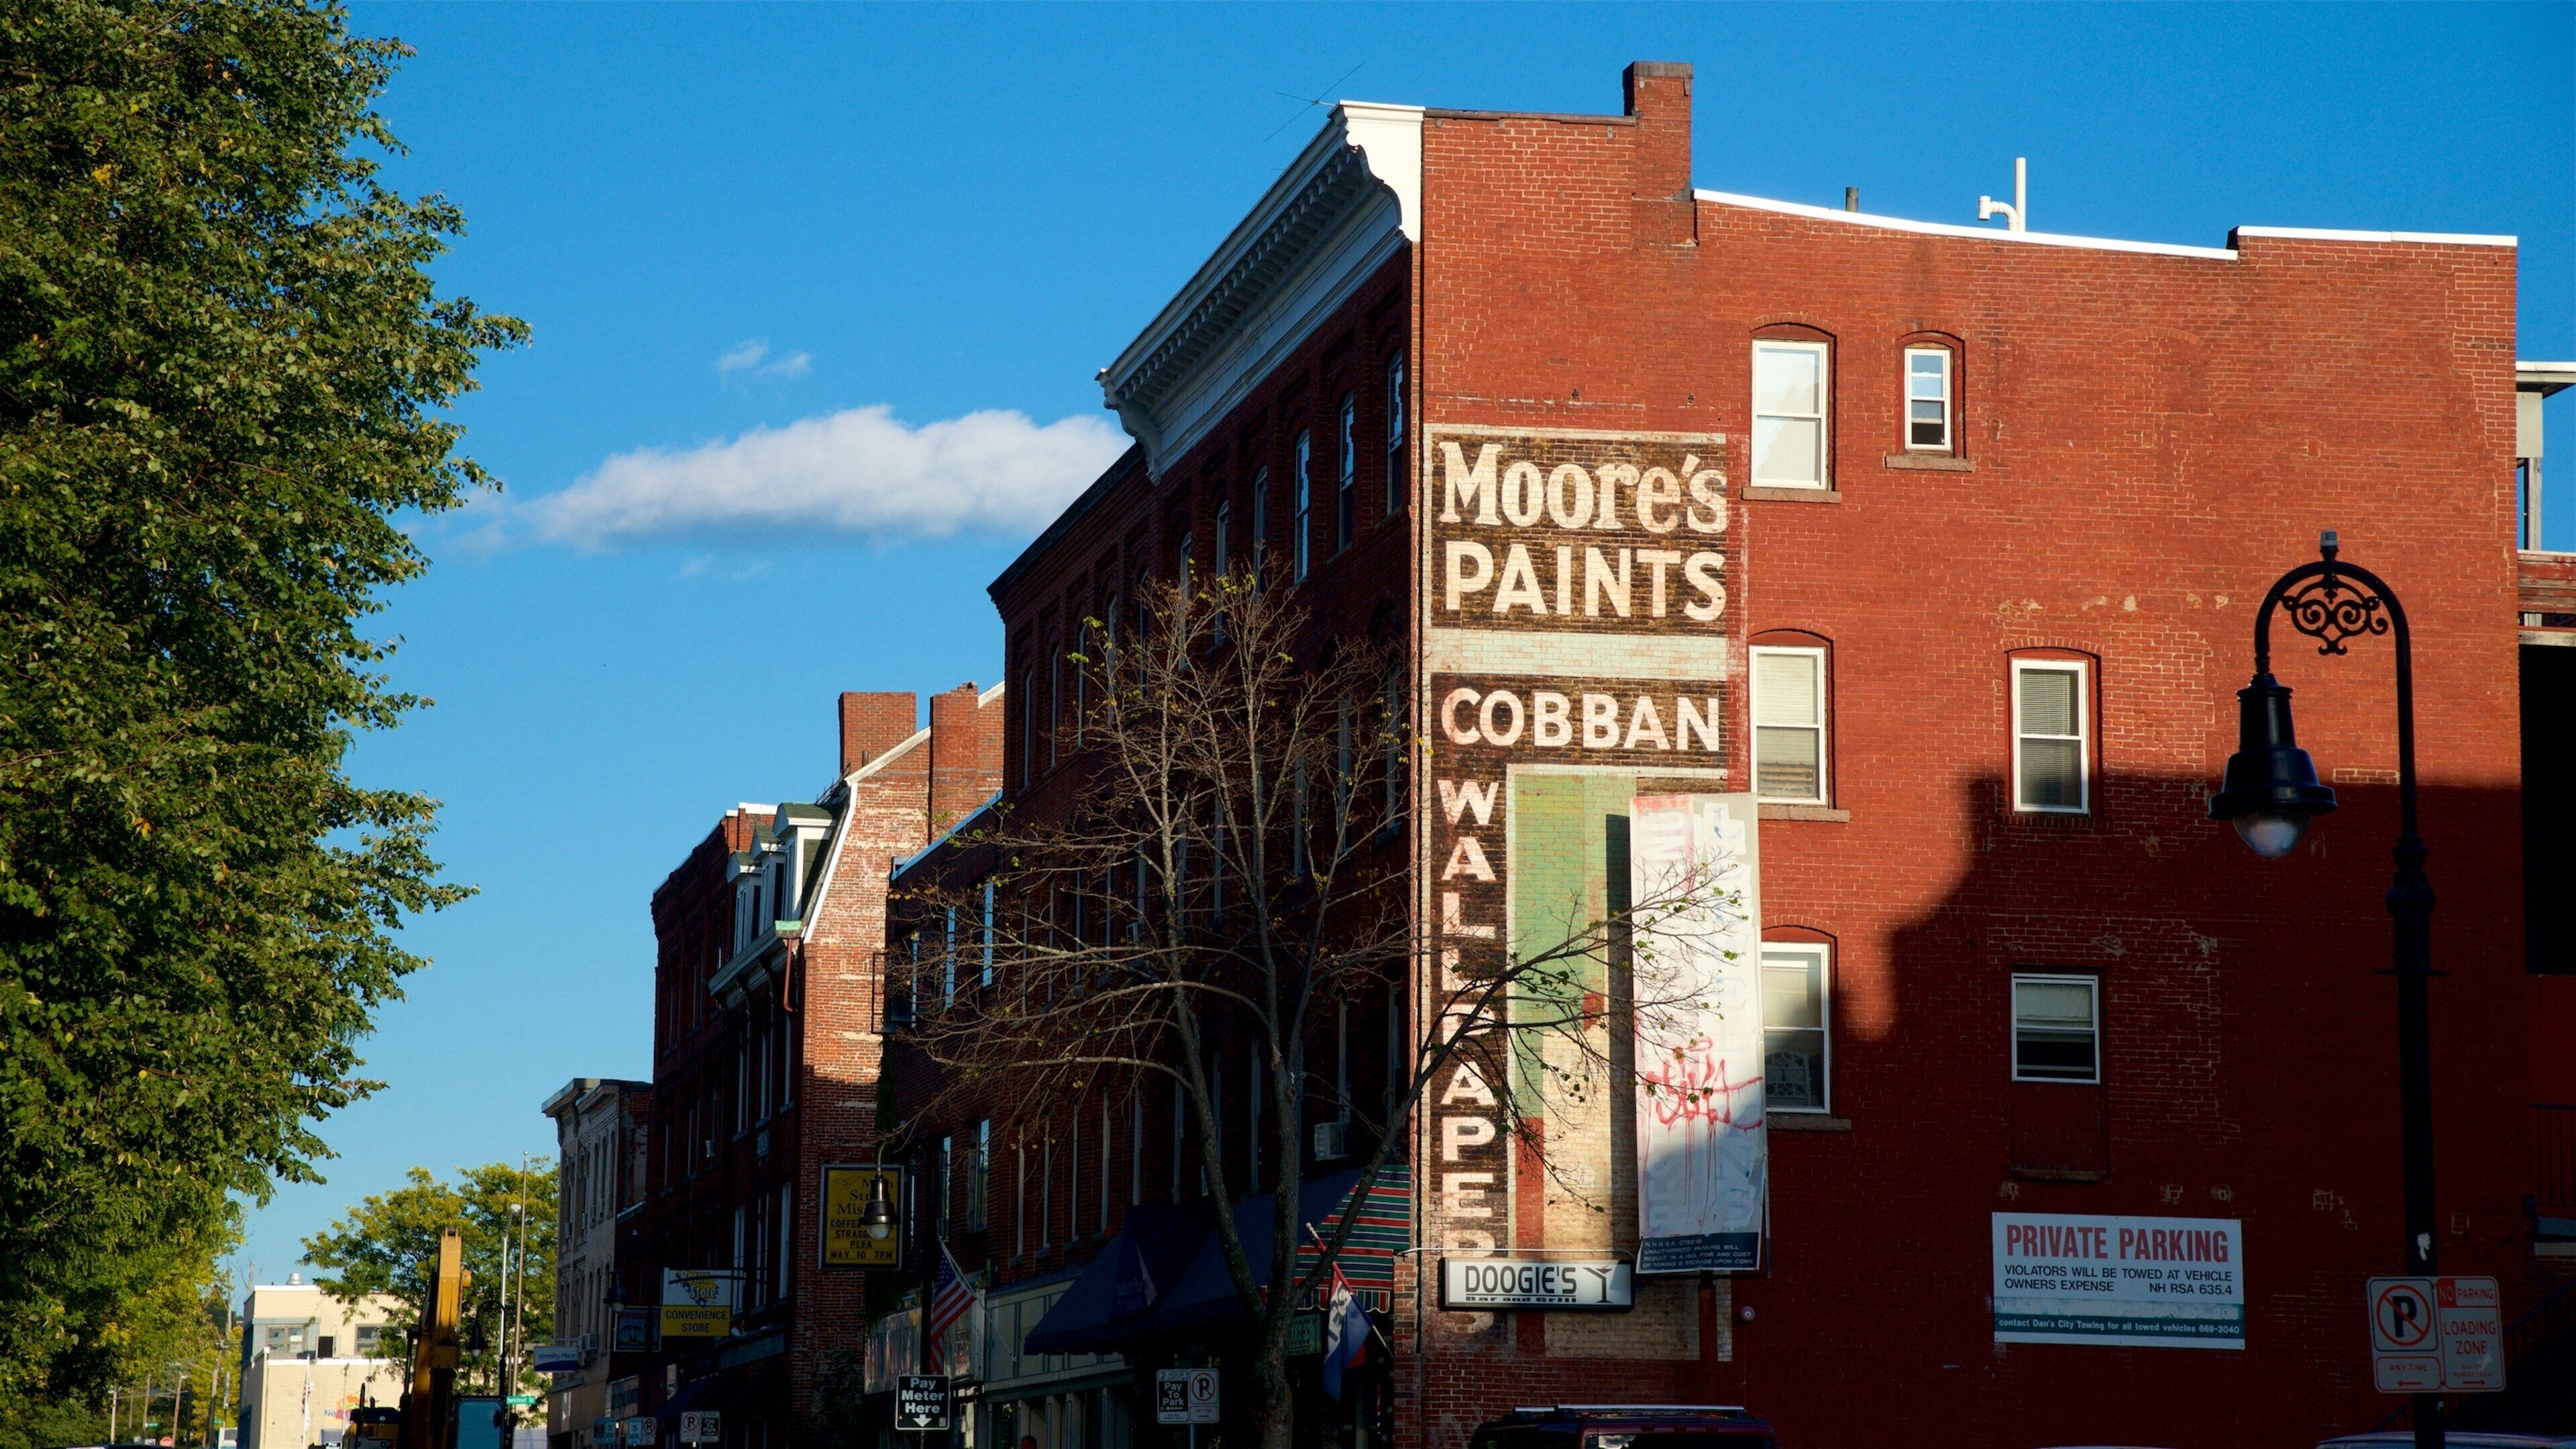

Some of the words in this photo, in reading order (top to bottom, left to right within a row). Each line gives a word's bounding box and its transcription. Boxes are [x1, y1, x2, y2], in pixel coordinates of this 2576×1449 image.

[1438, 441, 1729, 534] Moore's
[1446, 541, 1727, 622] PAINTS
[1441, 688, 1720, 752] COBBAN
[850, 1240, 872, 1248] PLEA
[2007, 1225, 2108, 1259] PRIVATE
[2119, 1228, 2229, 1262] PARKING
[830, 1251, 849, 1259] MAY
[857, 1251, 867, 1259] 10
[875, 1251, 893, 1259] 7PM
[1466, 1265, 1577, 1294] DOOGIE'S
[2004, 1265, 2067, 1277] VIOLATORS
[2072, 1267, 2098, 1278] WILL
[2102, 1268, 2116, 1278] BE
[2122, 1269, 2162, 1280] TOWED
[2167, 1270, 2181, 1280] AT
[2184, 1271, 2232, 1281] VEHICLE
[690, 1287, 717, 1299] Store
[2004, 1279, 2056, 1289] OWNERS
[2061, 1281, 2114, 1291] EXPENSE
[2149, 1283, 2165, 1293] NH
[2171, 1283, 2194, 1294] RSA
[2200, 1284, 2232, 1295] 635.4
[2439, 1286, 2455, 1303] NO
[2457, 1289, 2493, 1300] PARKING
[665, 1310, 727, 1320] CONVENIENCE
[682, 1323, 710, 1332] STORE
[1999, 1319, 2030, 1327] contact
[2033, 1319, 2055, 1328] Dan's
[2058, 1320, 2074, 1330] City
[2077, 1321, 2104, 1331] Towing
[2135, 1323, 2159, 1331] towed
[2163, 1324, 2196, 1332] vehicles
[2198, 1324, 2239, 1334] 669-3040
[2444, 1322, 2496, 1335] LOADING
[2456, 1341, 2487, 1354] ZONE
[910, 1377, 936, 1391] Pay
[1164, 1382, 1182, 1392] Pay
[901, 1389, 945, 1401] Meter
[1162, 1397, 1185, 1406] Park
[1167, 1391, 1179, 1399] To
[905, 1402, 941, 1413] Here
